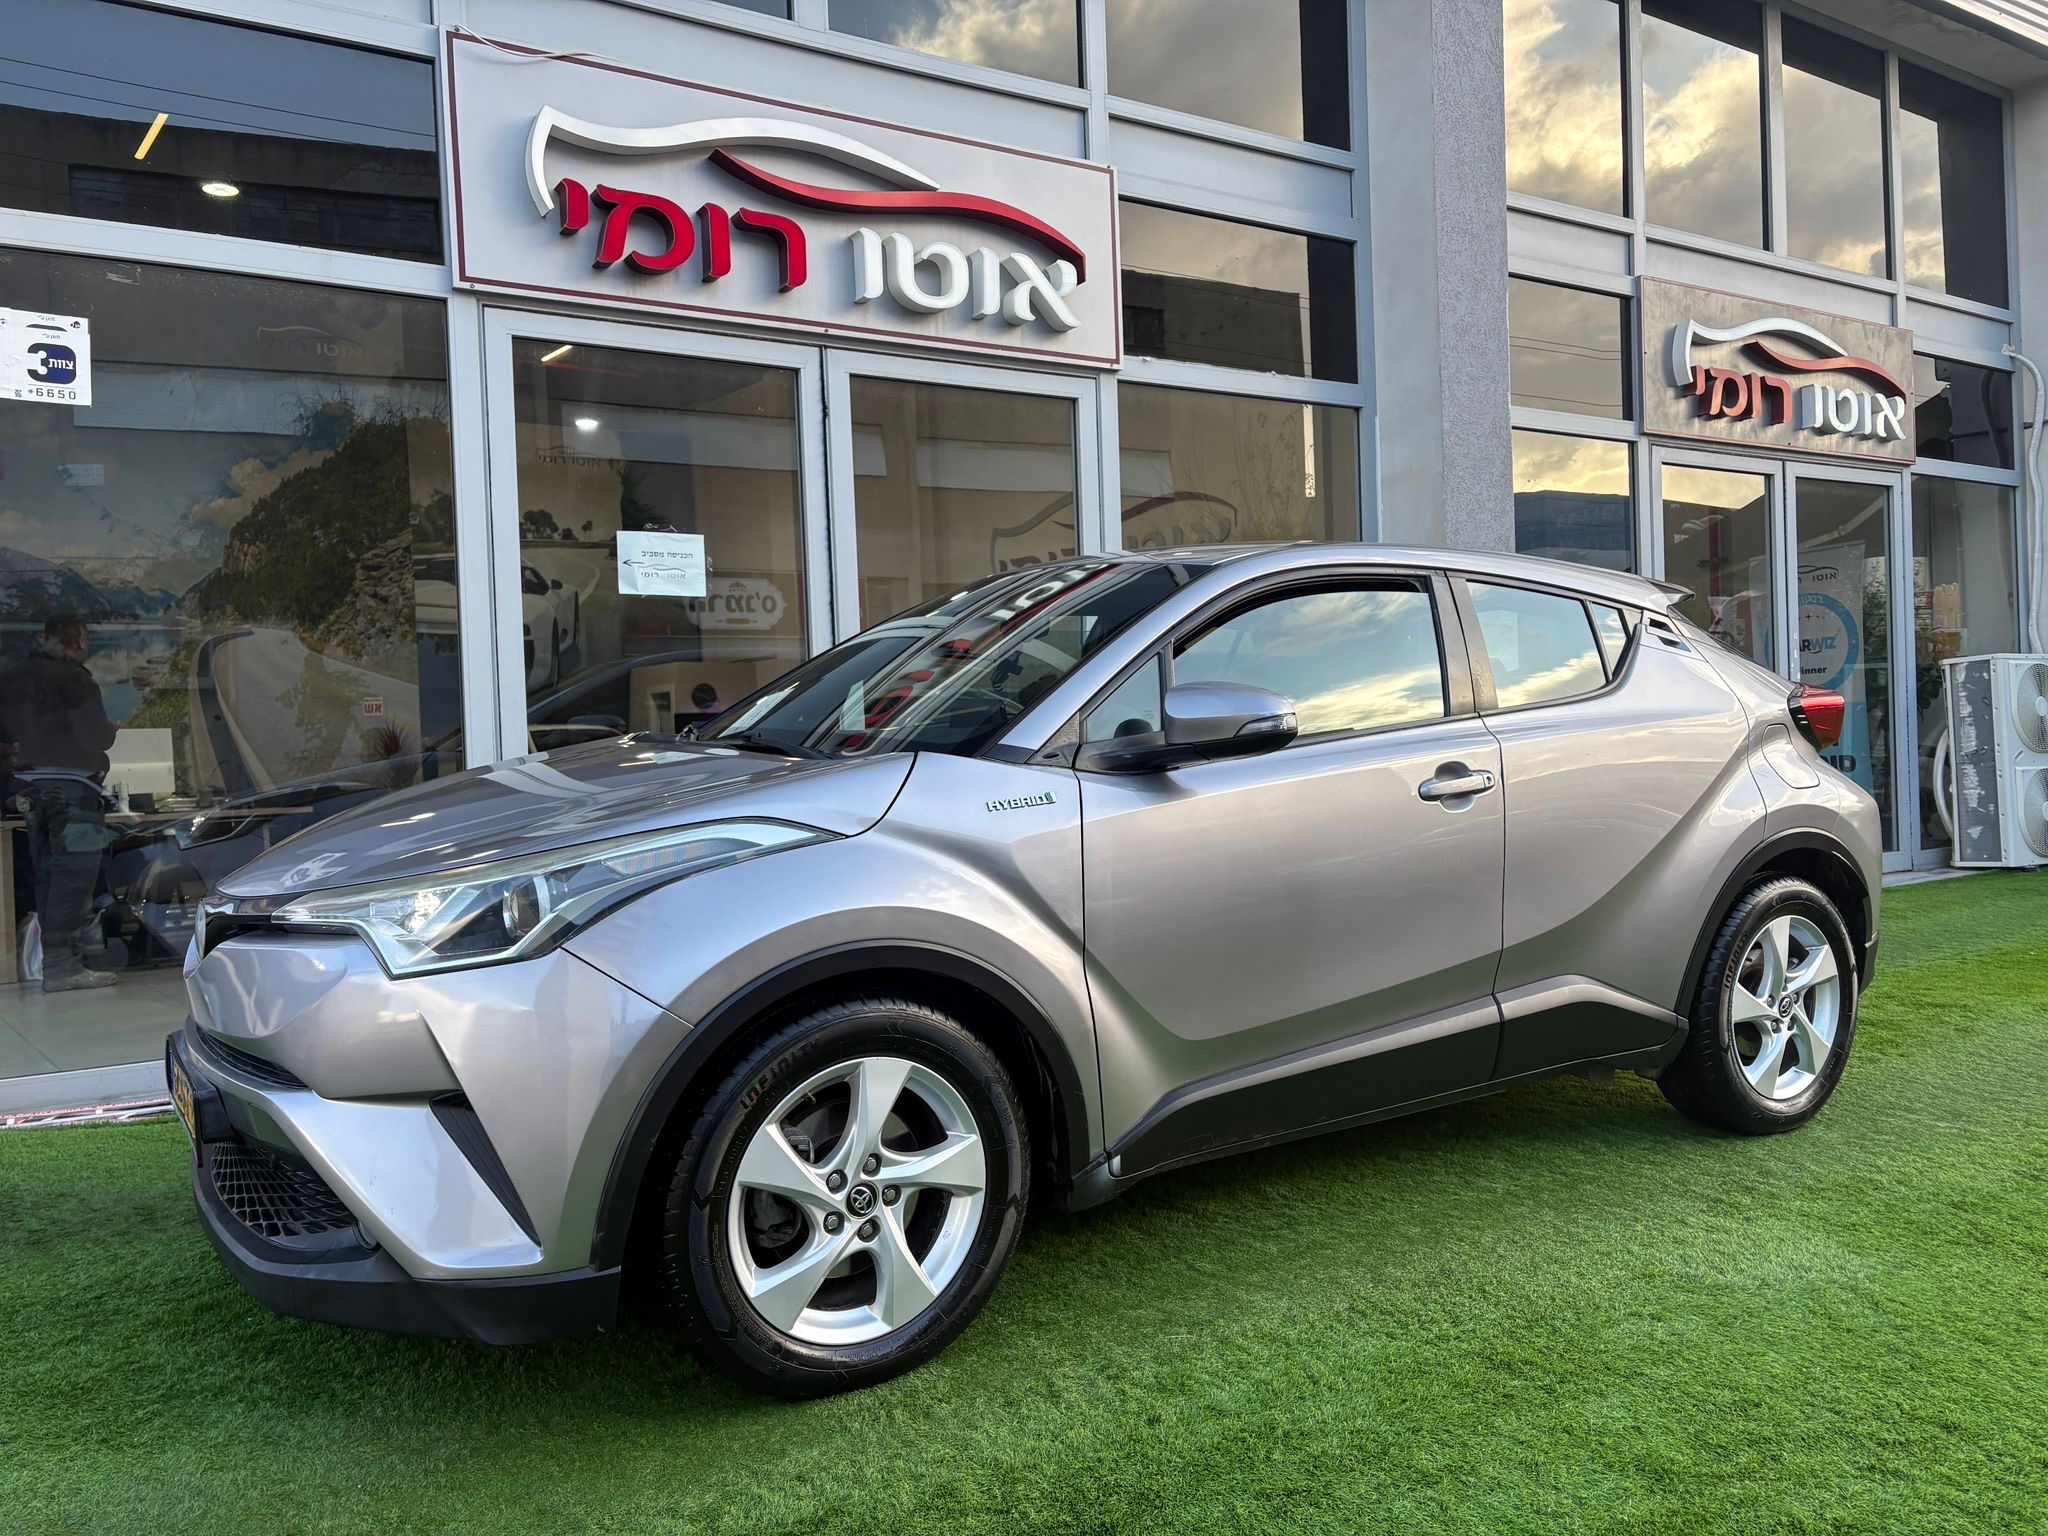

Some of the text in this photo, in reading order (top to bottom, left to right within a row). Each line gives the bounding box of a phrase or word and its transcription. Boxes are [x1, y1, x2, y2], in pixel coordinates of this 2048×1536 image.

[555, 177, 1081, 333] אוטו רומי
[48, 358, 74, 370] צוות
[1683, 366, 1906, 442] אוטו רומי
[641, 550, 665, 558] מסביב
[640, 571, 660, 579] רומי
[1812, 572, 1838, 582] אוטו
[1799, 636, 1838, 652] ARWIZ
[1801, 666, 1828, 675] inner
[986, 794, 1048, 812] HYBRID
